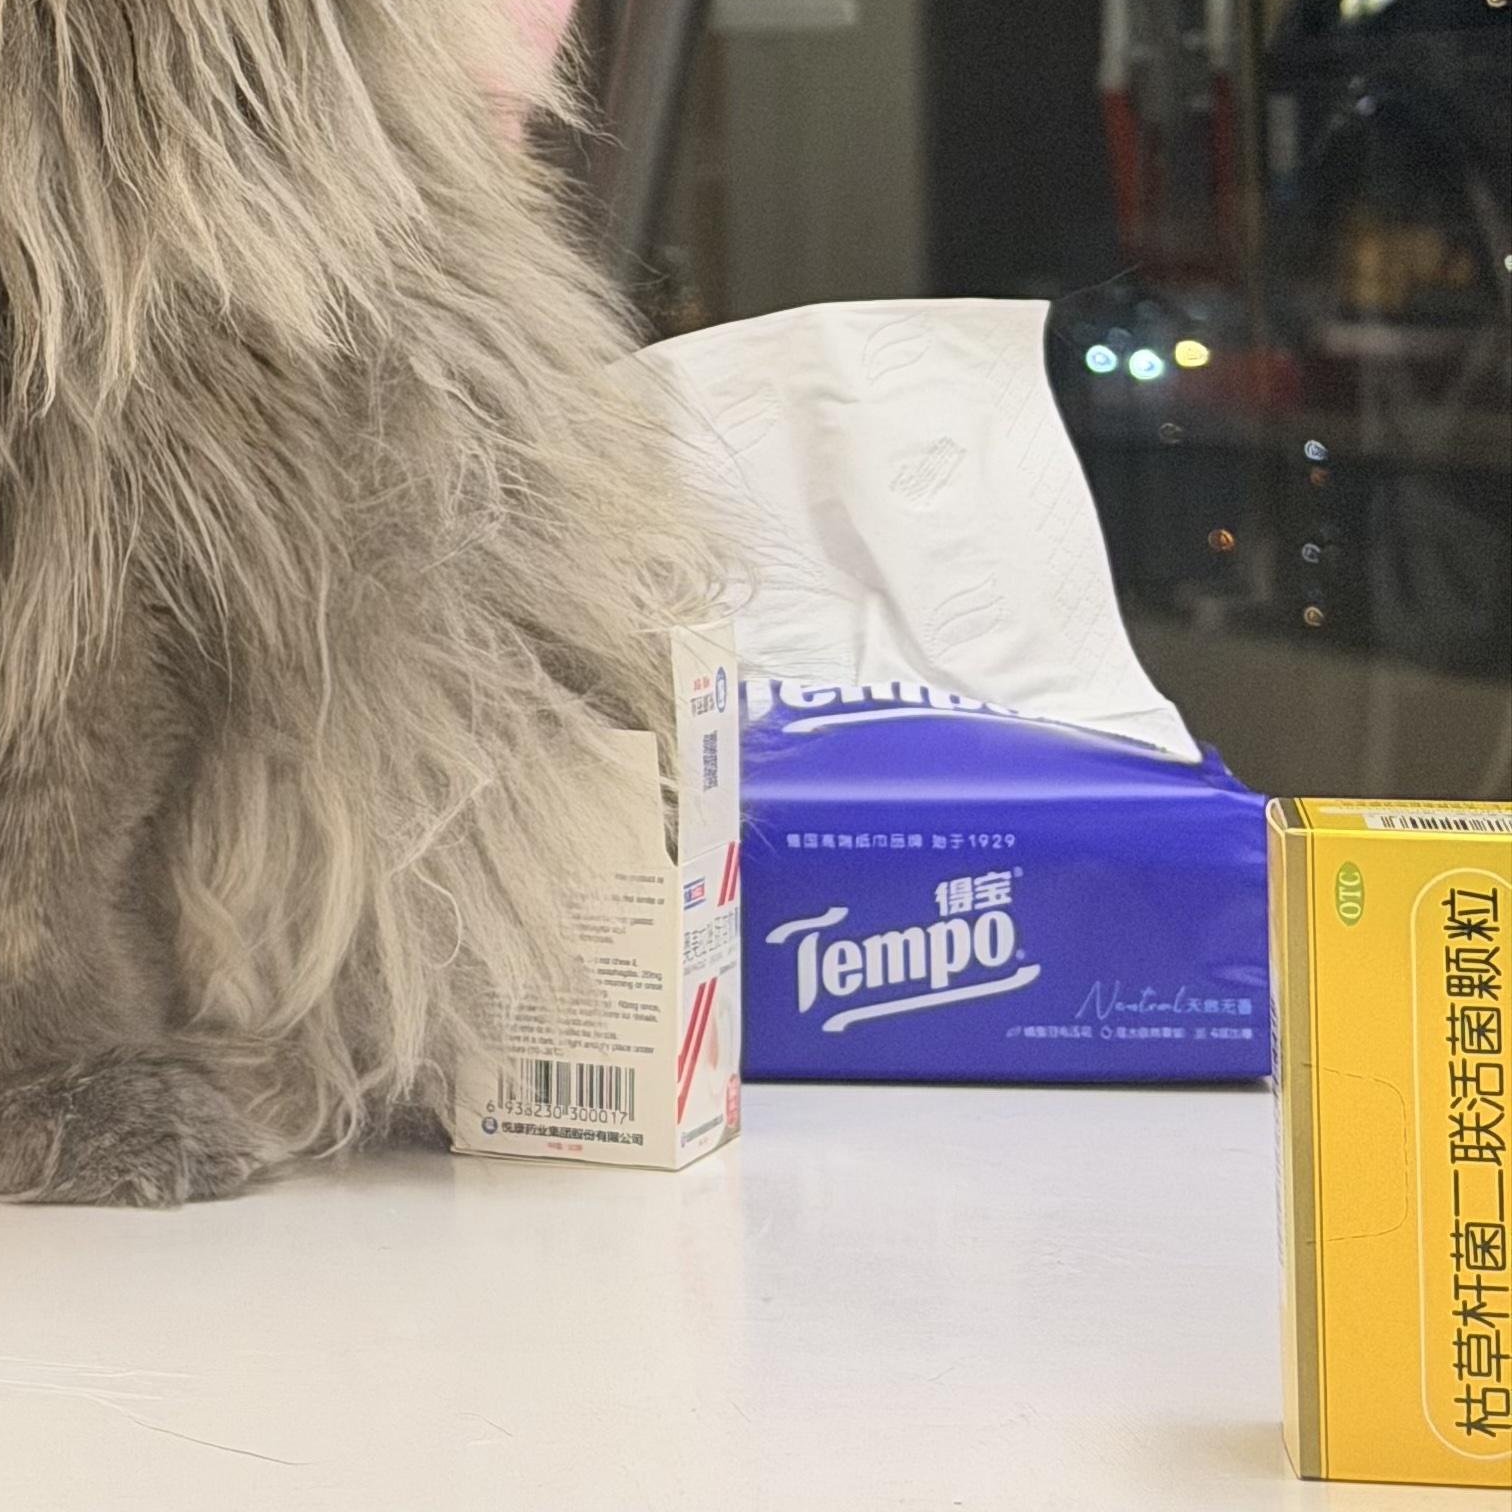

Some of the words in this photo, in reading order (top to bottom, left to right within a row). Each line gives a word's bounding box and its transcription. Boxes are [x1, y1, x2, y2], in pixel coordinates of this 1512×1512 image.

[935, 871, 1012, 916] 得宝
[1338, 872, 1362, 919] OTC
[765, 906, 1015, 1013] Tempo
[1075, 980, 1185, 1020] Neutral
[486, 1101, 495, 1113] 6
[570, 1107, 628, 1125] 300017
[1441, 887, 1512, 1438] 枯草杆菌二联活菌颗粒
